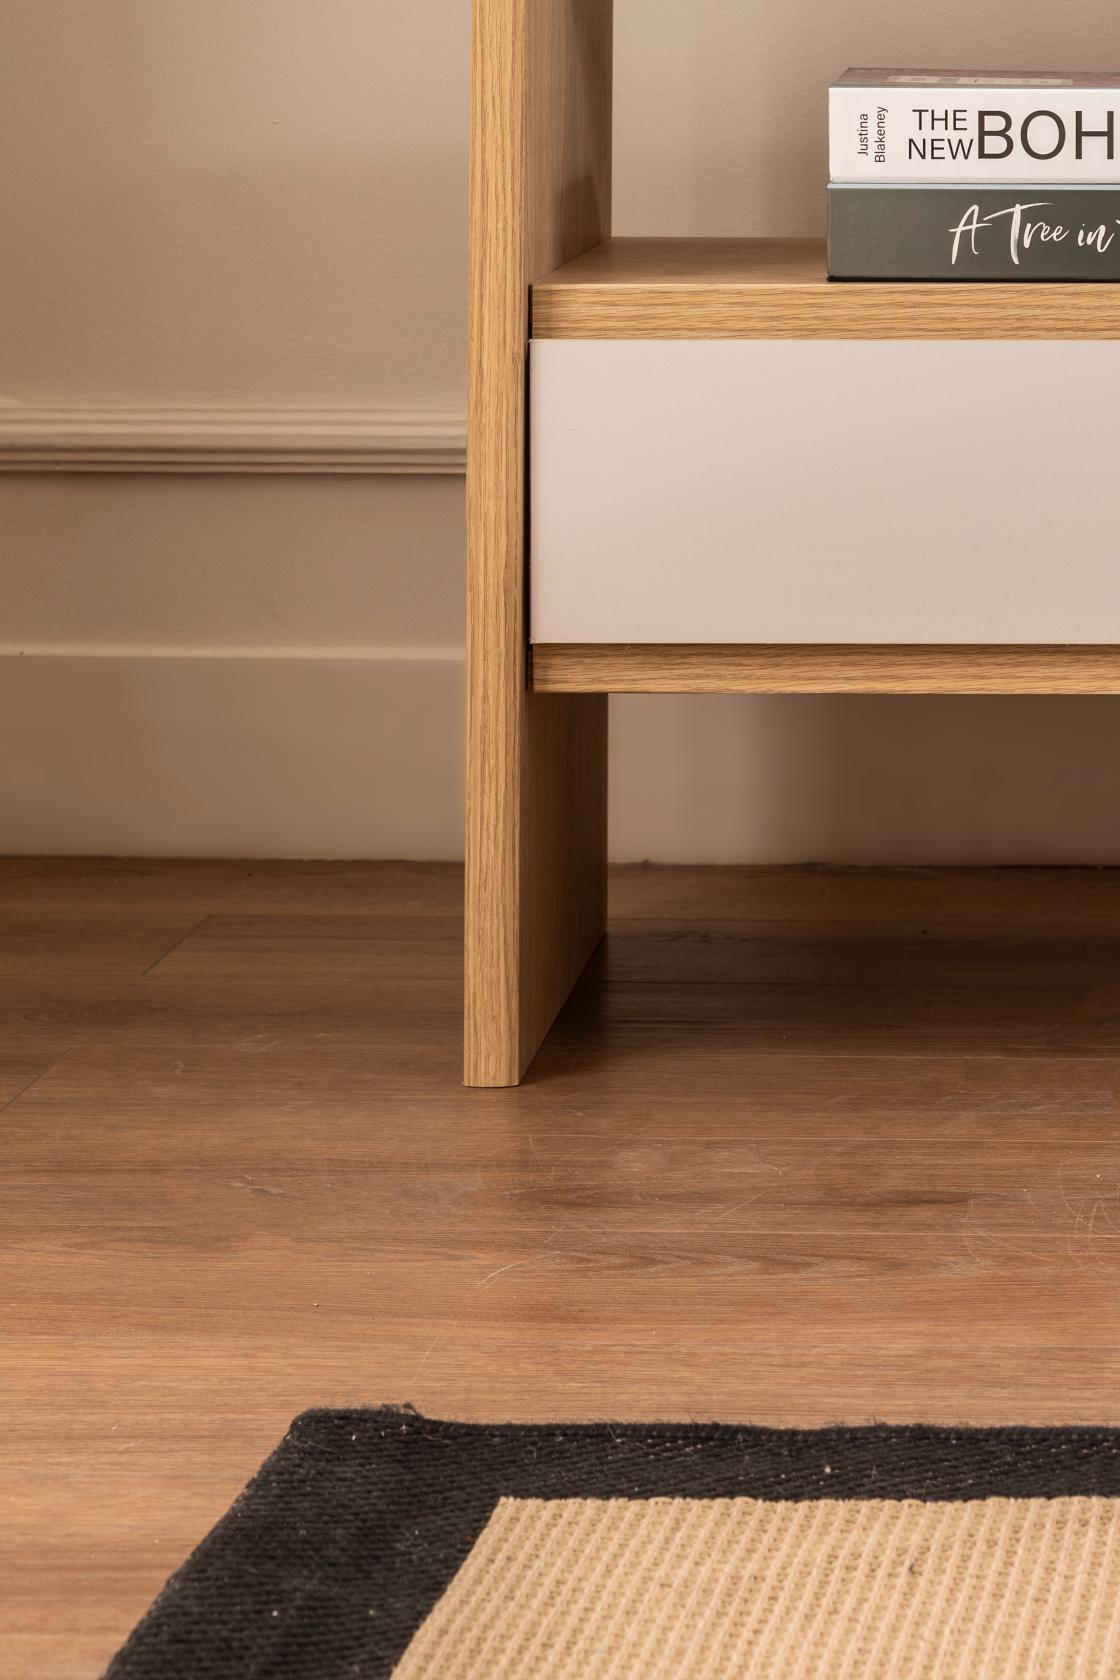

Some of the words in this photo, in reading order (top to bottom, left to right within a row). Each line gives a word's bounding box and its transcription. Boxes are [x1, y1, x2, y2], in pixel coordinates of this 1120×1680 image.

[857, 113, 869, 157] Justina
[875, 106, 889, 163] Blakeney
[912, 109, 968, 131] THE
[908, 138, 974, 160] NEW
[948, 204, 993, 265] A
[983, 202, 1069, 265] Tree
[1077, 223, 1115, 253] in
